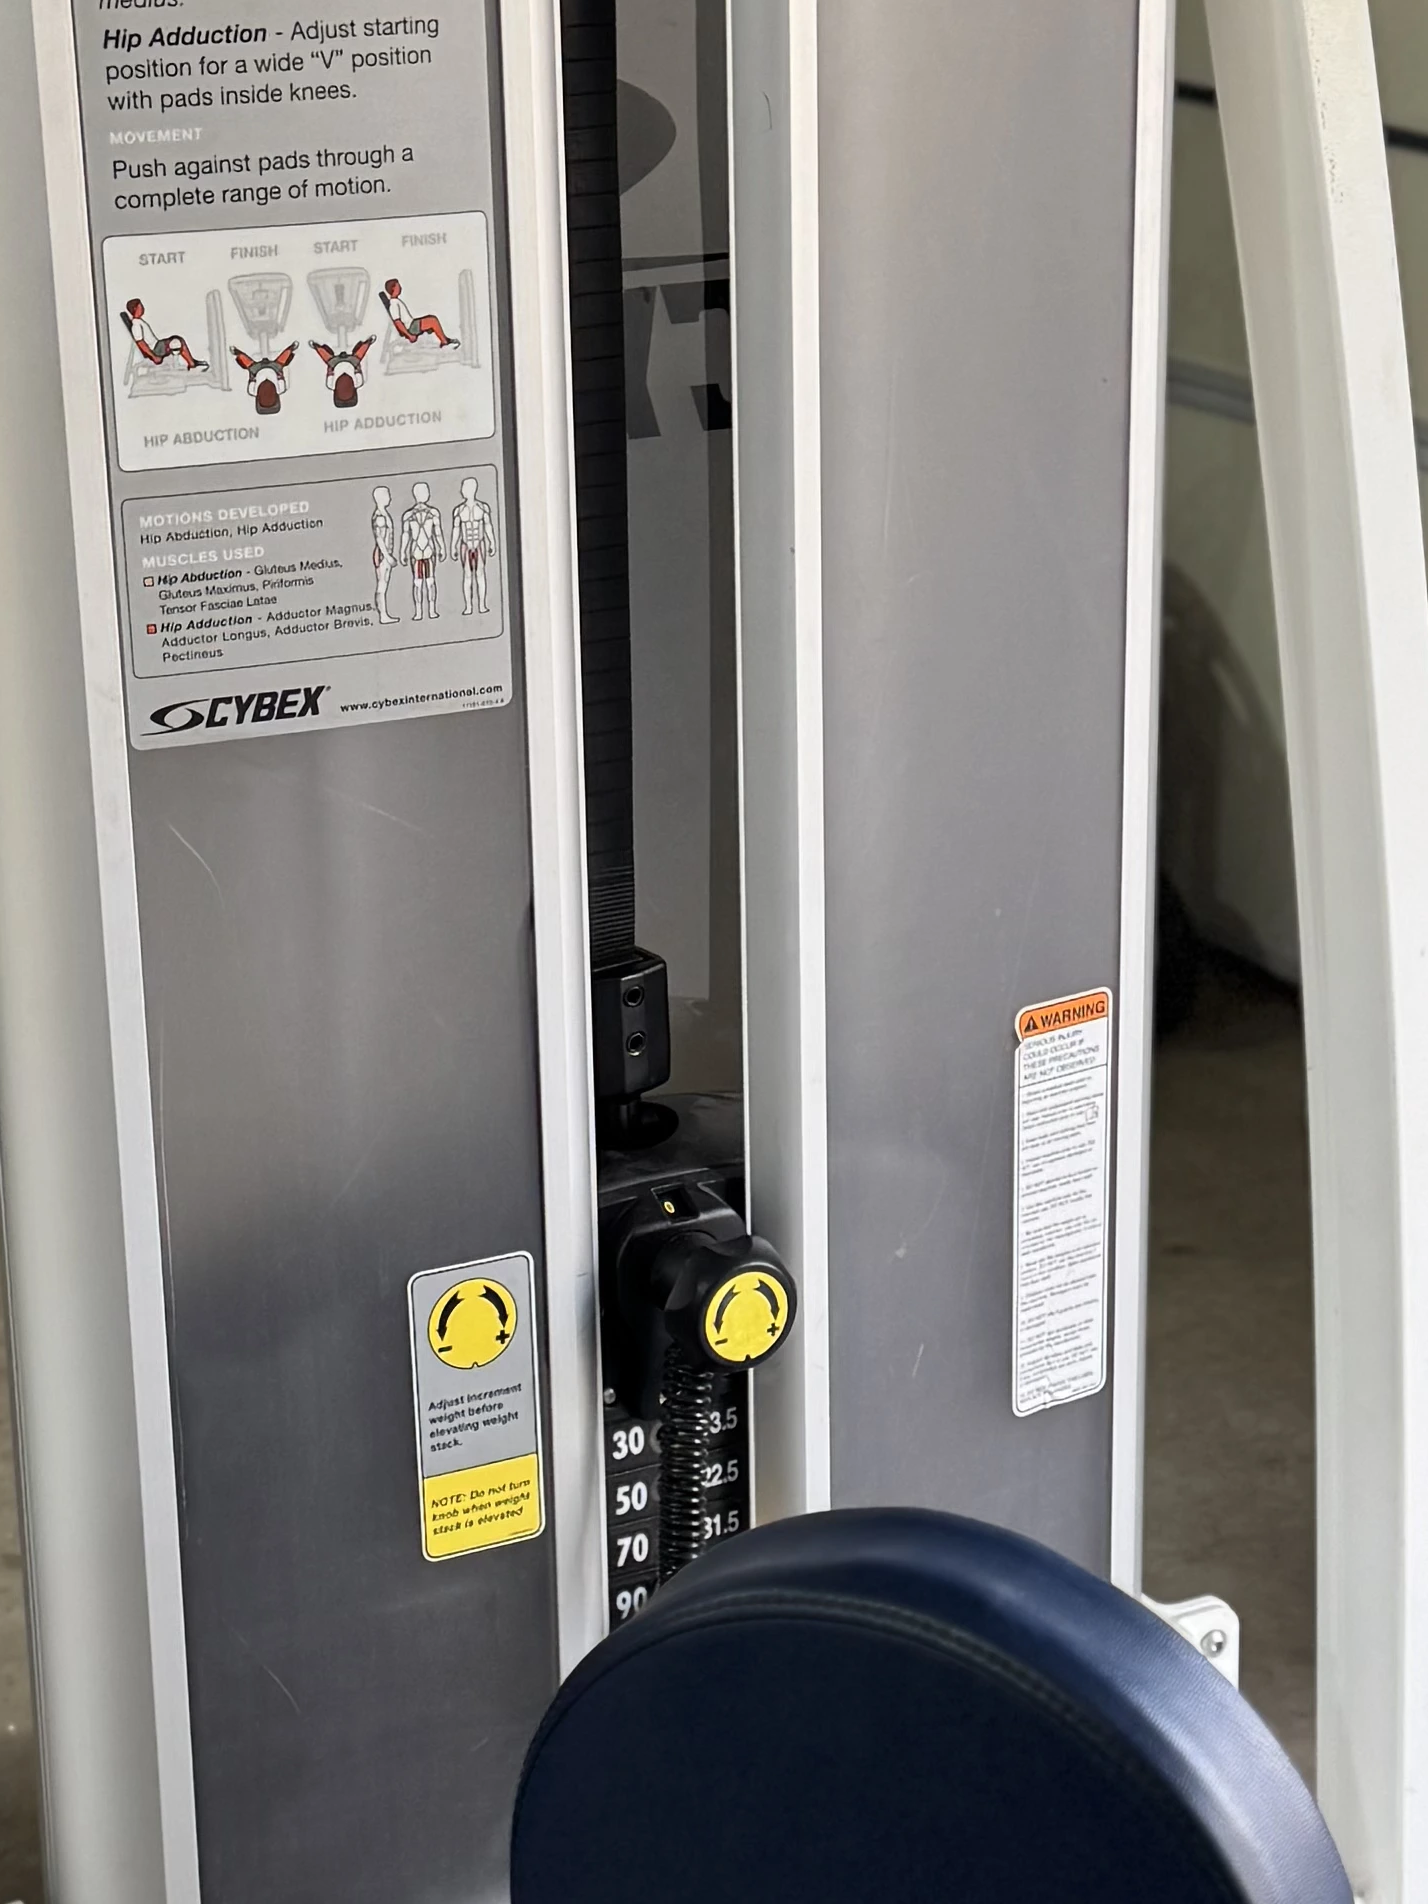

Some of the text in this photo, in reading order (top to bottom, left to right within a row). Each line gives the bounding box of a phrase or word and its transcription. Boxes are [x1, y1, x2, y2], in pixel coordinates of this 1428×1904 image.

[102, 28, 142, 50] Hip
[148, 25, 267, 47] Adduction
[290, 21, 357, 44] Adjust
[363, 16, 439, 39] starting
[106, 58, 193, 85] position
[198, 56, 229, 76] for
[235, 60, 248, 74] a
[254, 52, 304, 73] wide
[351, 46, 432, 73] position
[108, 82, 357, 114] with pads inside knees.
[109, 128, 203, 145] MOVEMENT
[113, 145, 413, 180] Push against pads through a
[114, 175, 391, 214] complete range of motion.
[230, 244, 278, 259] FINISH
[313, 240, 358, 254] START
[402, 233, 447, 247] FINISH
[139, 251, 186, 266] START
[324, 410, 442, 433] HIP ADDUCTION
[143, 427, 260, 448] HIP ABDUCTION
[139, 501, 309, 528] MOTIONS DEVELOPED
[140, 519, 323, 544] Hip Abduction, Hip Adduction
[141, 547, 265, 568] MUSCLES USED
[158, 575, 178, 587] Hip
[181, 569, 242, 583] Abduction
[161, 623, 182, 634] Hip
[186, 616, 252, 629] Adduction
[266, 609, 321, 621] Adductor
[162, 635, 218, 647] Adductor
[275, 622, 330, 635] Adductor
[340, 684, 503, 713] www.cybexinternational.com
[1040, 1000, 1105, 1028] WARNING
[428, 1383, 522, 1411] Adjust increment
[429, 1402, 503, 1425] weight before
[430, 1411, 519, 1439] elevating weight
[710, 1407, 737, 1433] 3.5
[431, 1439, 463, 1452] stack.
[612, 1426, 645, 1460] 30
[471, 1490, 484, 1499] Do
[488, 1484, 506, 1495] not
[616, 1482, 647, 1515] 50
[432, 1492, 530, 1521] knob when weight
[617, 1533, 648, 1567] 70
[616, 1586, 648, 1619] 90
